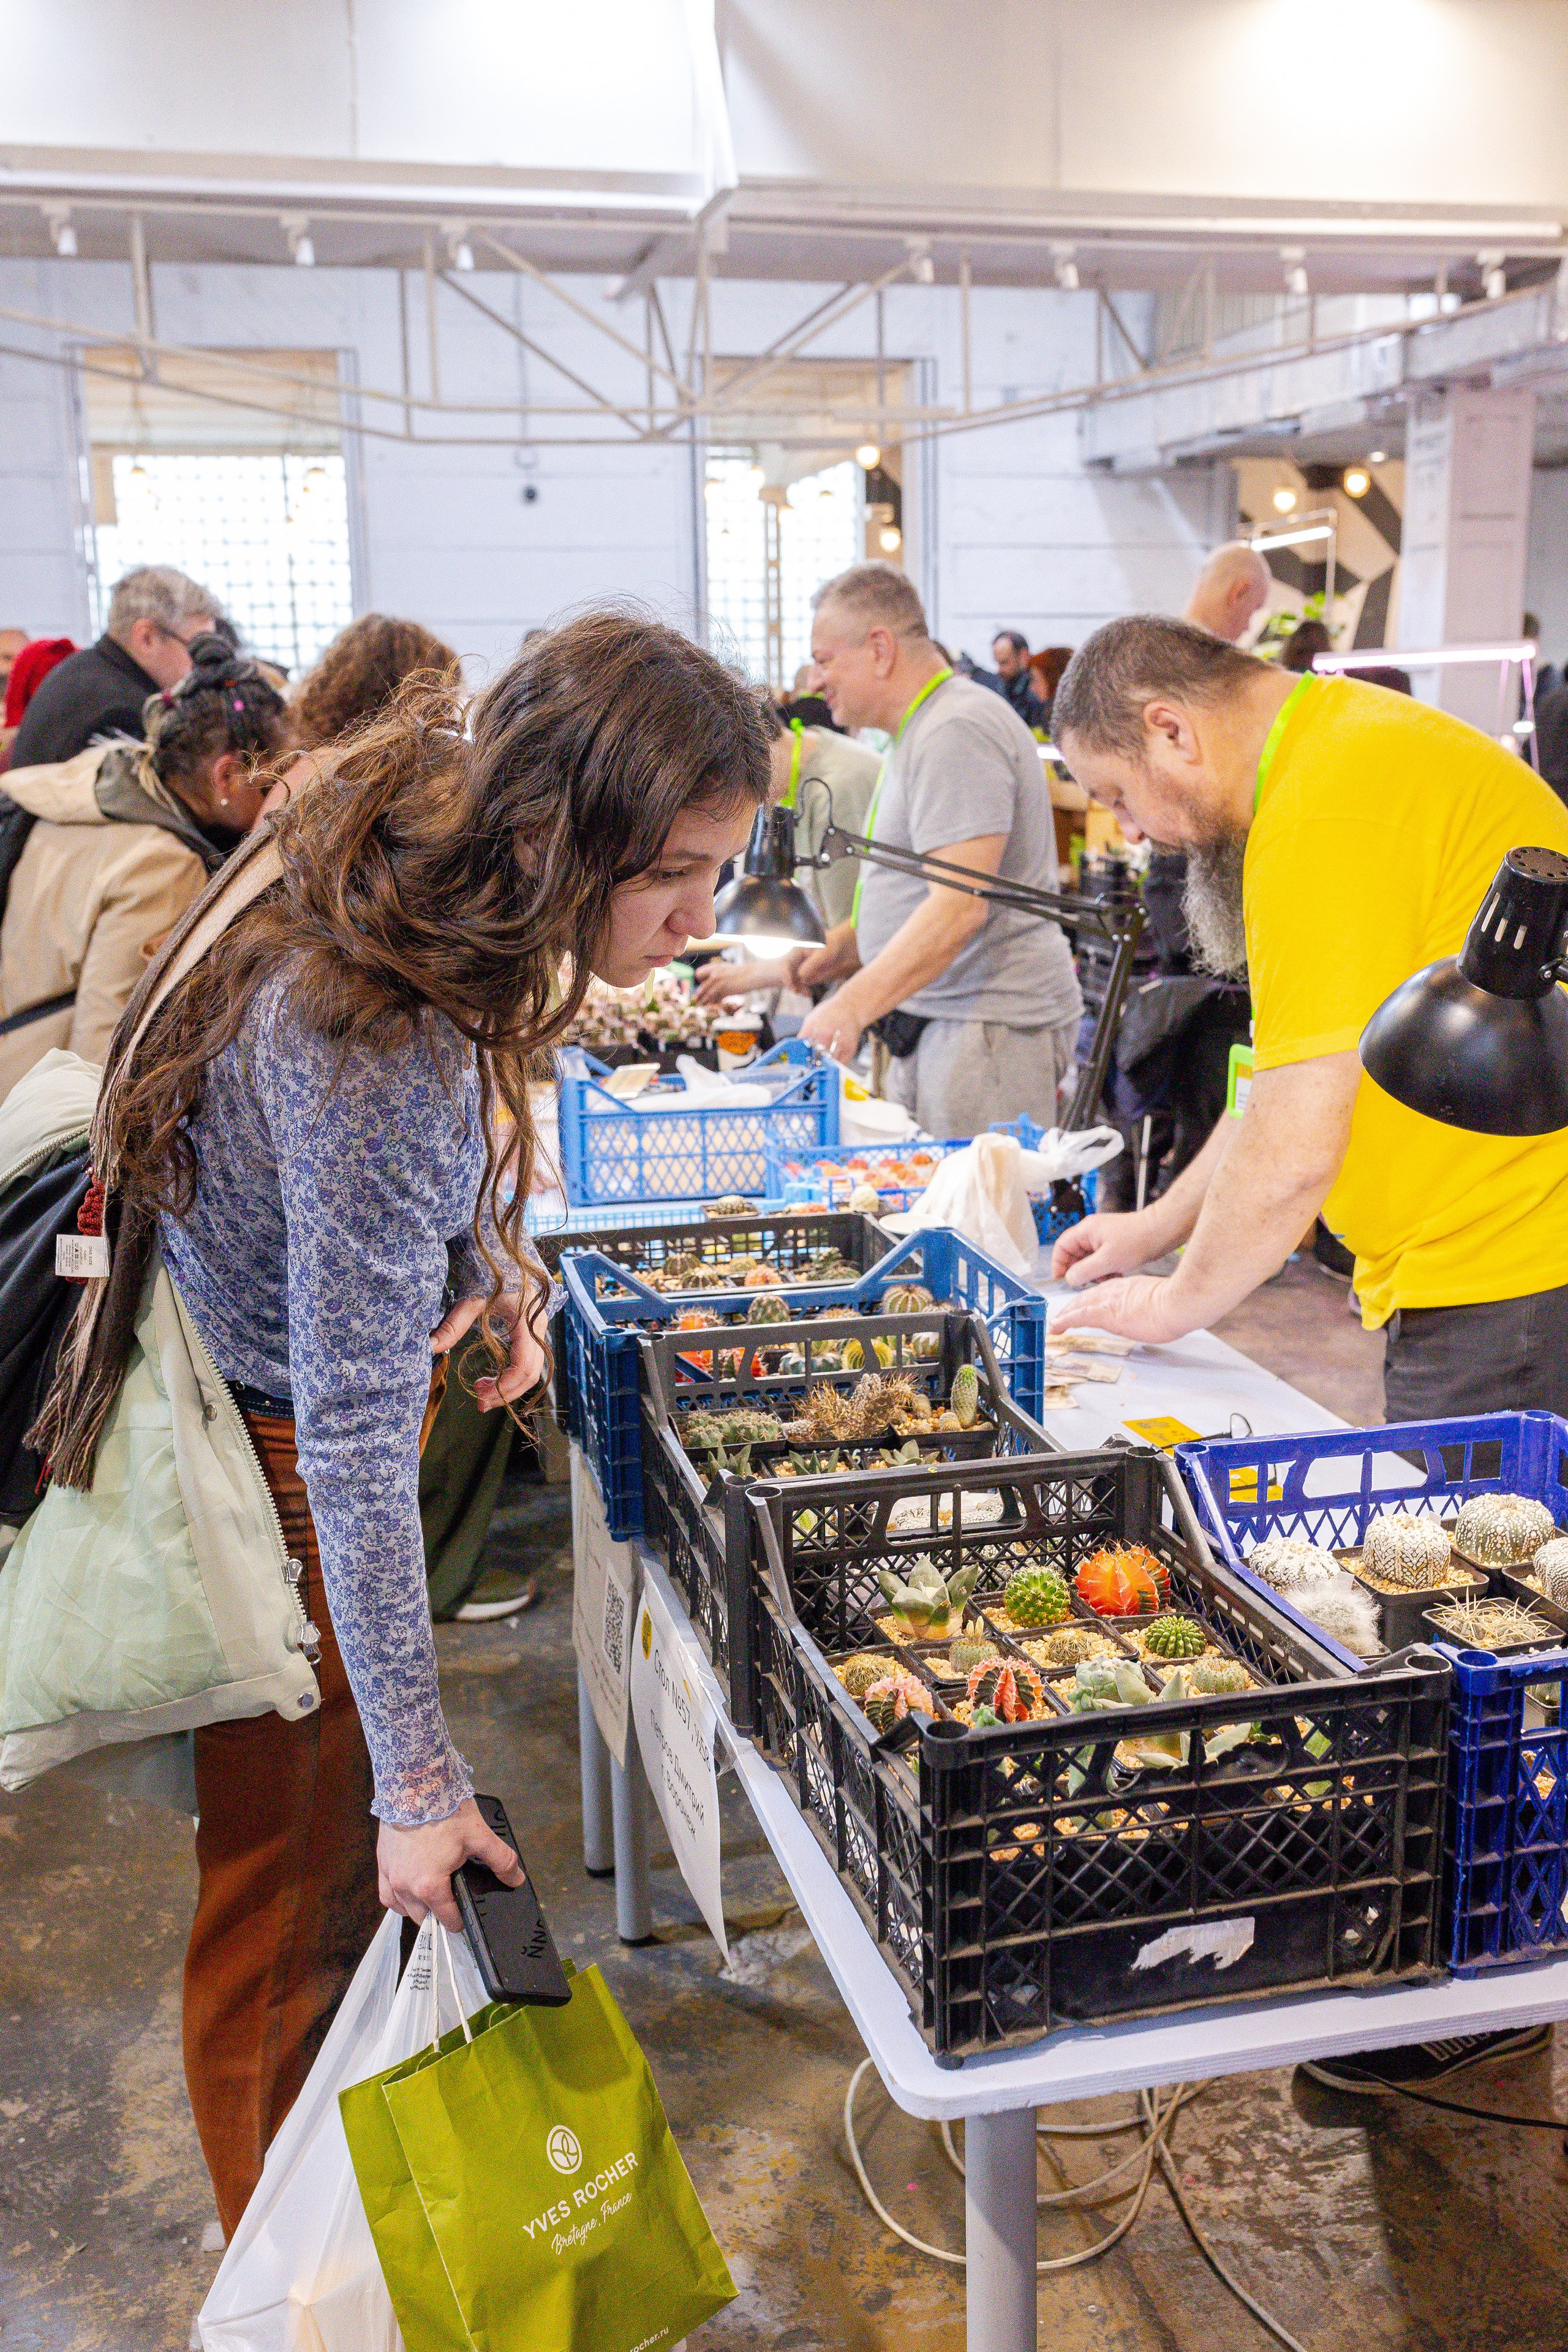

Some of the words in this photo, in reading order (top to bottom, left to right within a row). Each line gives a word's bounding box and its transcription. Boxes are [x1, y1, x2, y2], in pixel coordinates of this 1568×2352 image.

[654, 1649, 669, 1696] Стол
[650, 1709, 673, 1764] Петров
[674, 1754, 704, 1826] Дмитрий
[522, 2199, 571, 2239] YVES
[572, 2152, 638, 2208] ROCHER
[600, 2192, 632, 2223] France
